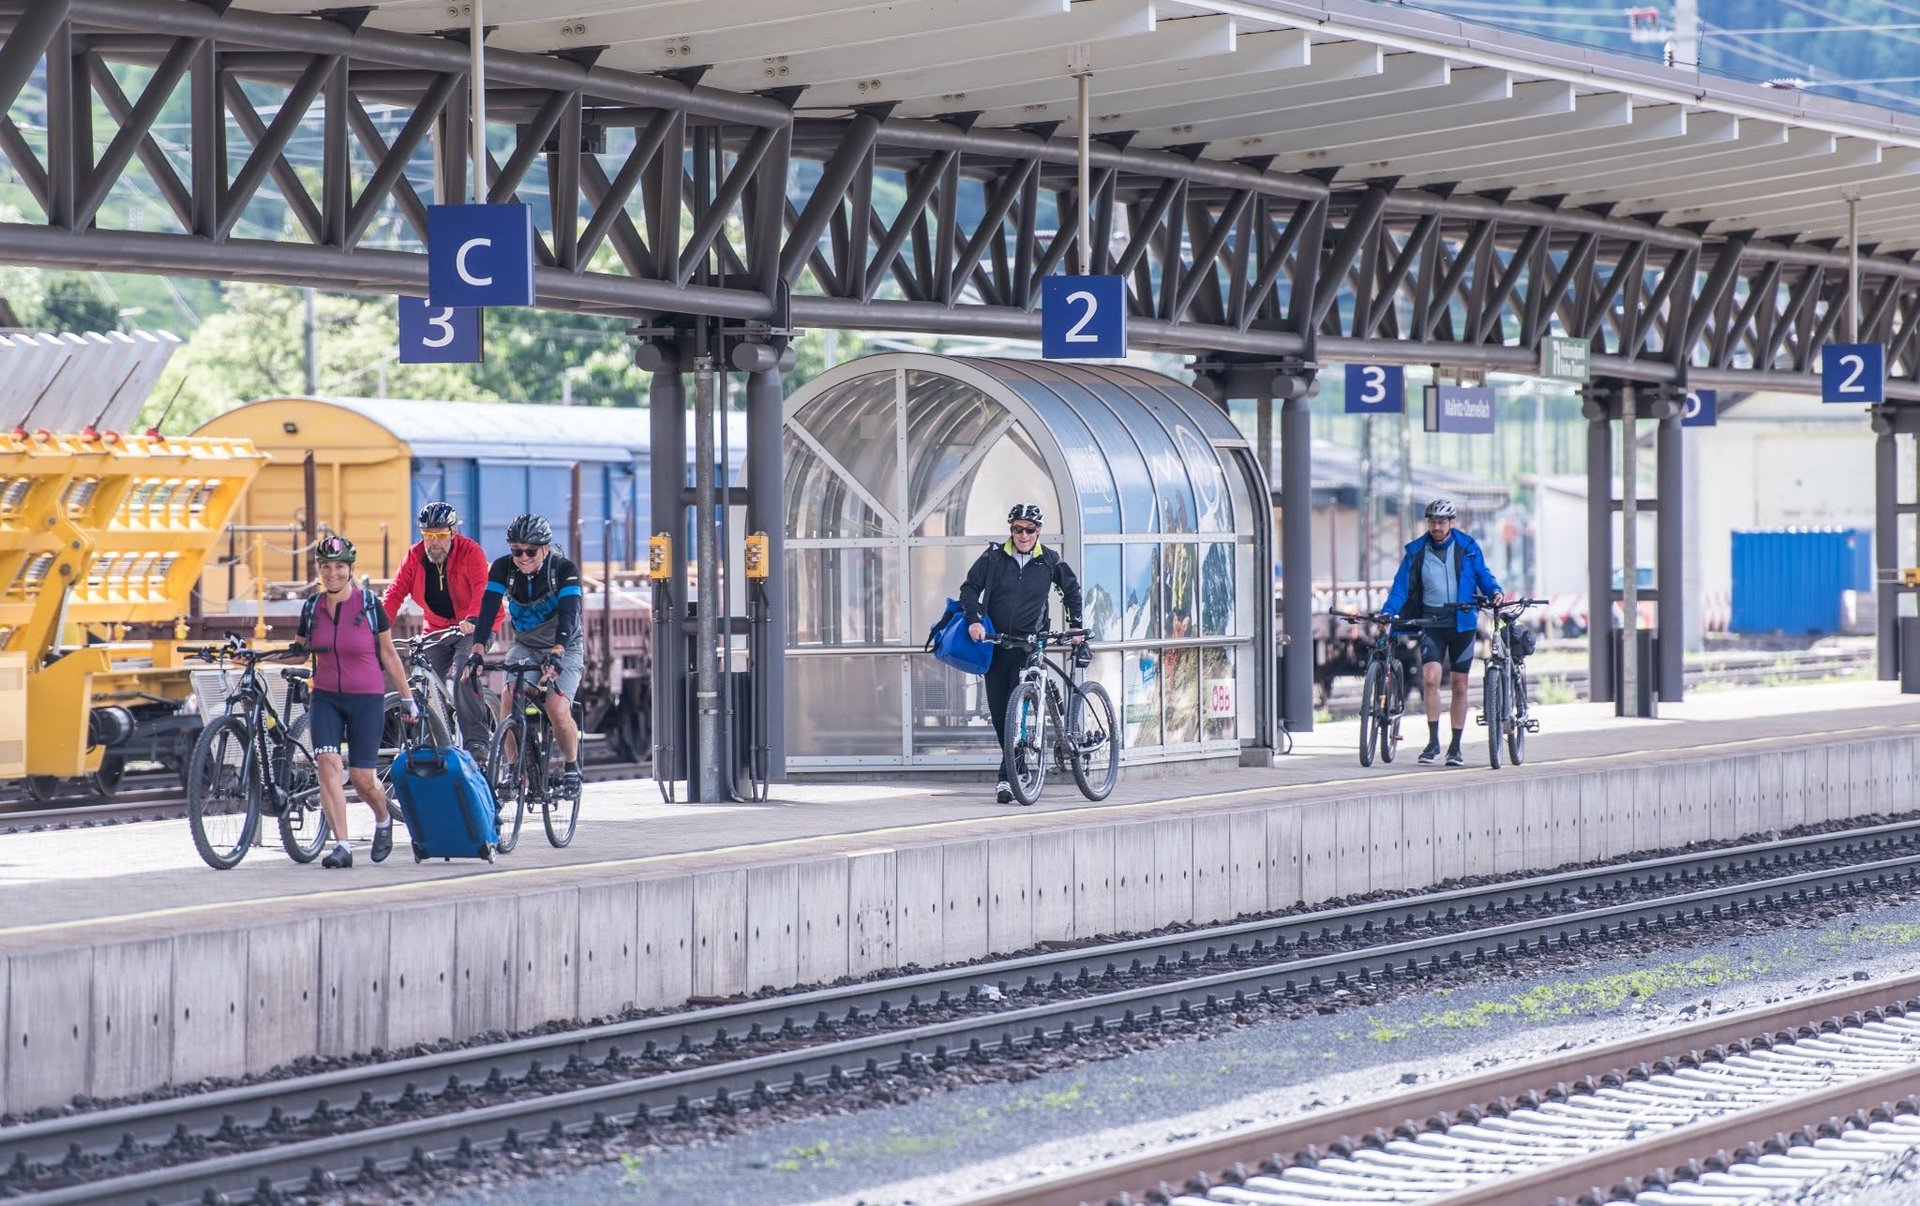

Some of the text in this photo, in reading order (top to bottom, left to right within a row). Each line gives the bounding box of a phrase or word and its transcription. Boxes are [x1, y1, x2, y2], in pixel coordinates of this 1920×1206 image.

[455, 238, 492, 286] C
[422, 299, 455, 348] 3
[1065, 291, 1099, 343] 2
[1360, 366, 1386, 404] 3
[1839, 354, 1866, 393] 2
